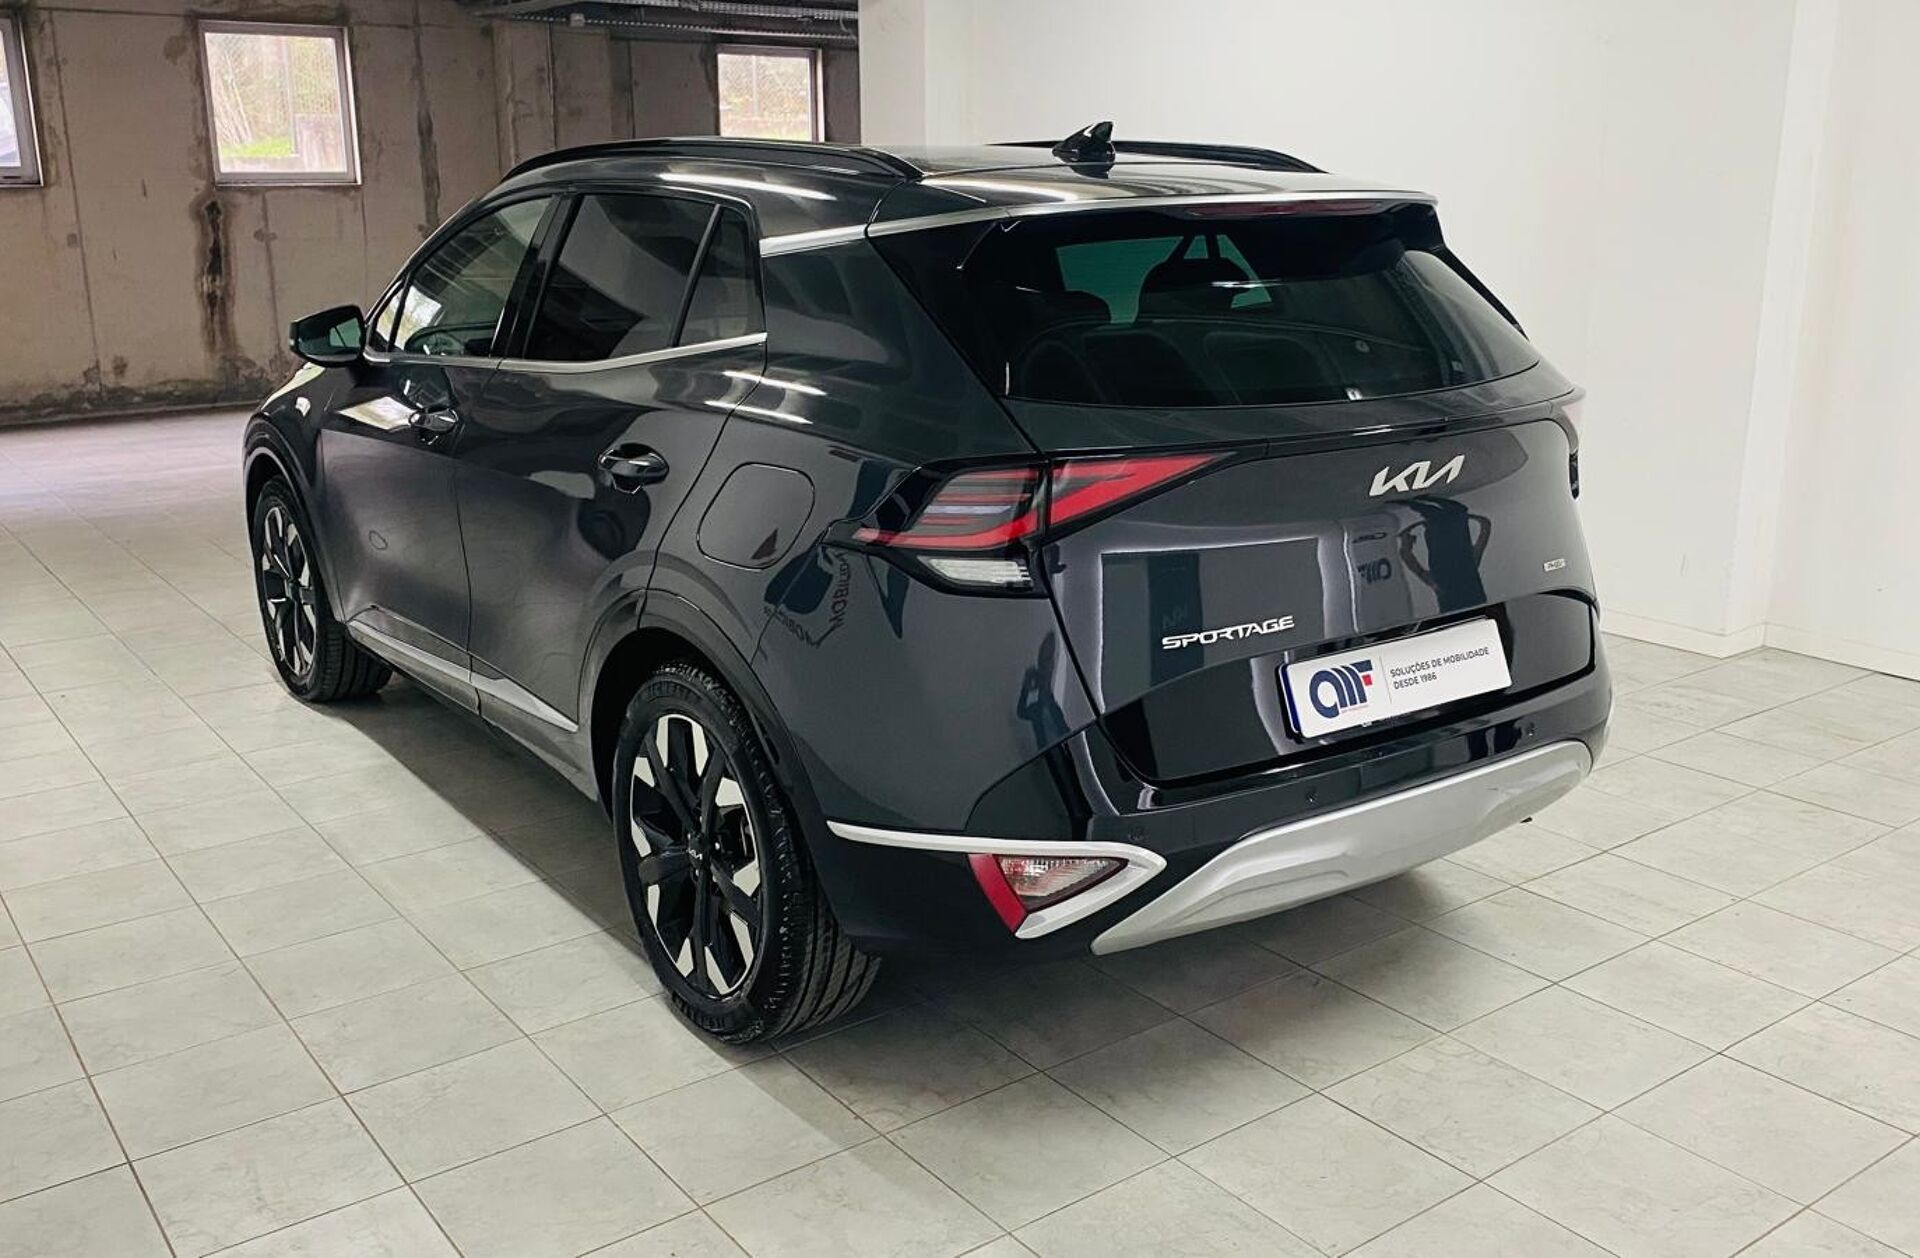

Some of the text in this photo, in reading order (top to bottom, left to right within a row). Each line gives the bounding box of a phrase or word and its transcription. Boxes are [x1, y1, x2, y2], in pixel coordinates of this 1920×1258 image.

[1369, 455, 1465, 497] KIA
[1162, 616, 1295, 650] SPORTAGE
[1431, 658, 1442, 668] DE
[1443, 646, 1490, 666] MOBILIDADE
[1393, 672, 1437, 690] DESDE 1986
